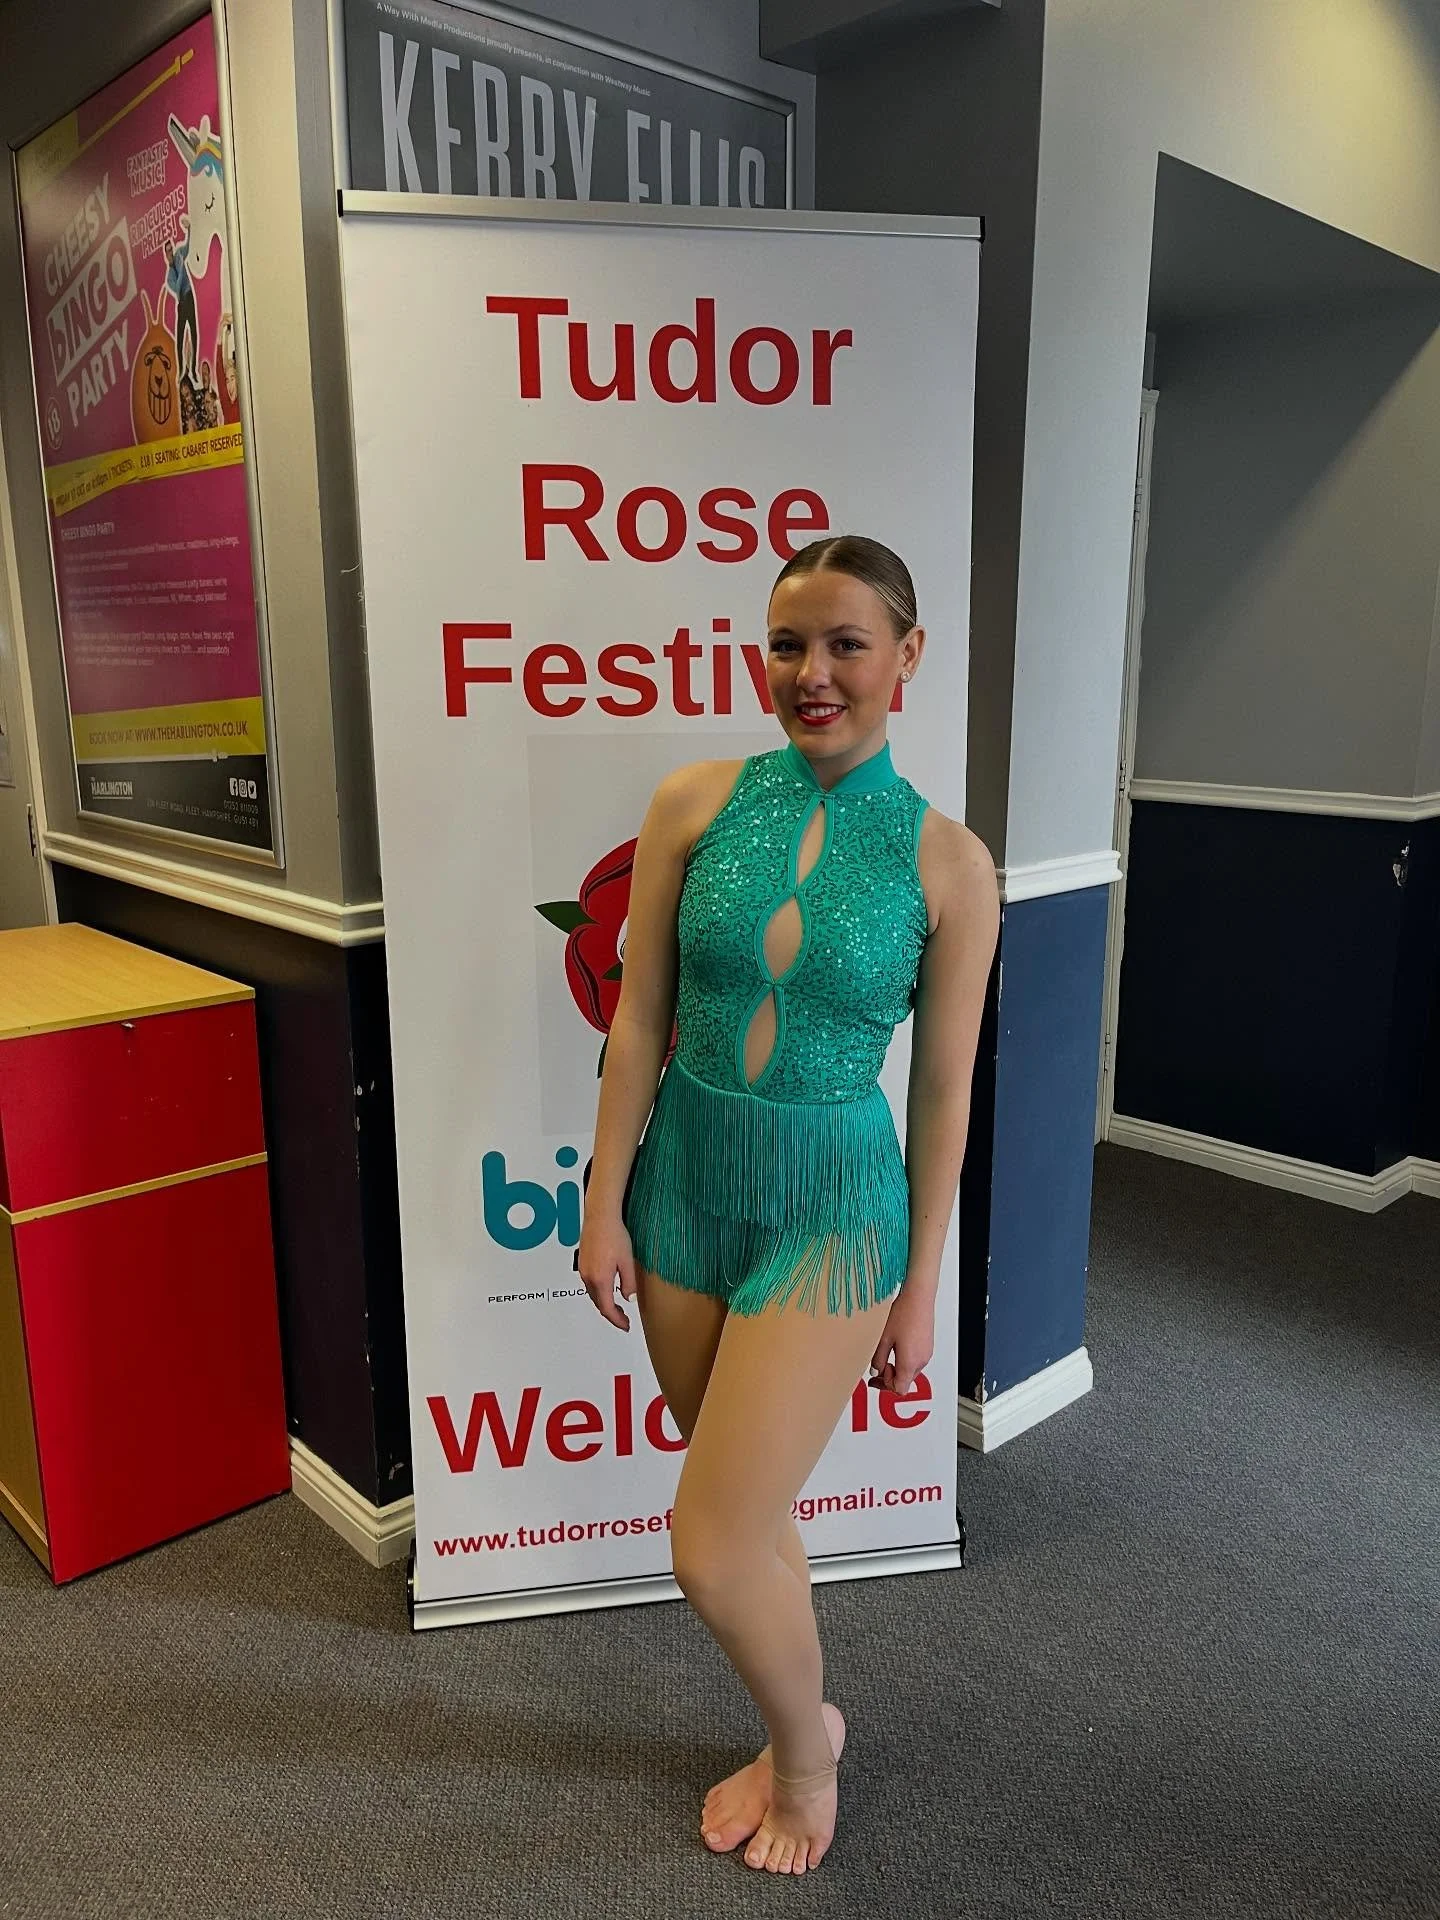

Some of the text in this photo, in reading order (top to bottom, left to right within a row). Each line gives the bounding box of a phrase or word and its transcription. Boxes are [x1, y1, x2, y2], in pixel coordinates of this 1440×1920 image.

[384, 4, 400, 17] Way
[401, 9, 420, 21] With
[420, 15, 442, 30] Media
[443, 23, 486, 43] Productions
[486, 38, 513, 54] proudly
[513, 47, 545, 64] presents,
[545, 56, 552, 64] in
[552, 59, 590, 77] conjunction
[590, 70, 604, 82] with
[604, 75, 633, 93] Westway
[632, 85, 651, 97] Music
[379, 31, 597, 200] KERRY
[127, 139, 169, 177] FANTASTIC
[129, 160, 167, 197] MUSIC!
[44, 172, 110, 296] CHEESY
[130, 184, 186, 247] RIDICULOUS
[141, 214, 177, 259] PRIZES!
[67, 319, 129, 427] PARTY
[486, 296, 853, 406] Tudor
[47, 408, 61, 441] 18
[155, 448, 180, 465] SEATING:
[182, 441, 209, 458] CABARET
[210, 433, 243, 452] RESERVED
[521, 463, 830, 563] Rose
[89, 731, 107, 745] BOOK
[107, 730, 124, 744] NOW
[135, 720, 249, 744] WWW.THEHARLINGTON.CO.UK
[91, 781, 134, 796] HARLINGTON
[488, 1292, 546, 1304] PERFORM
